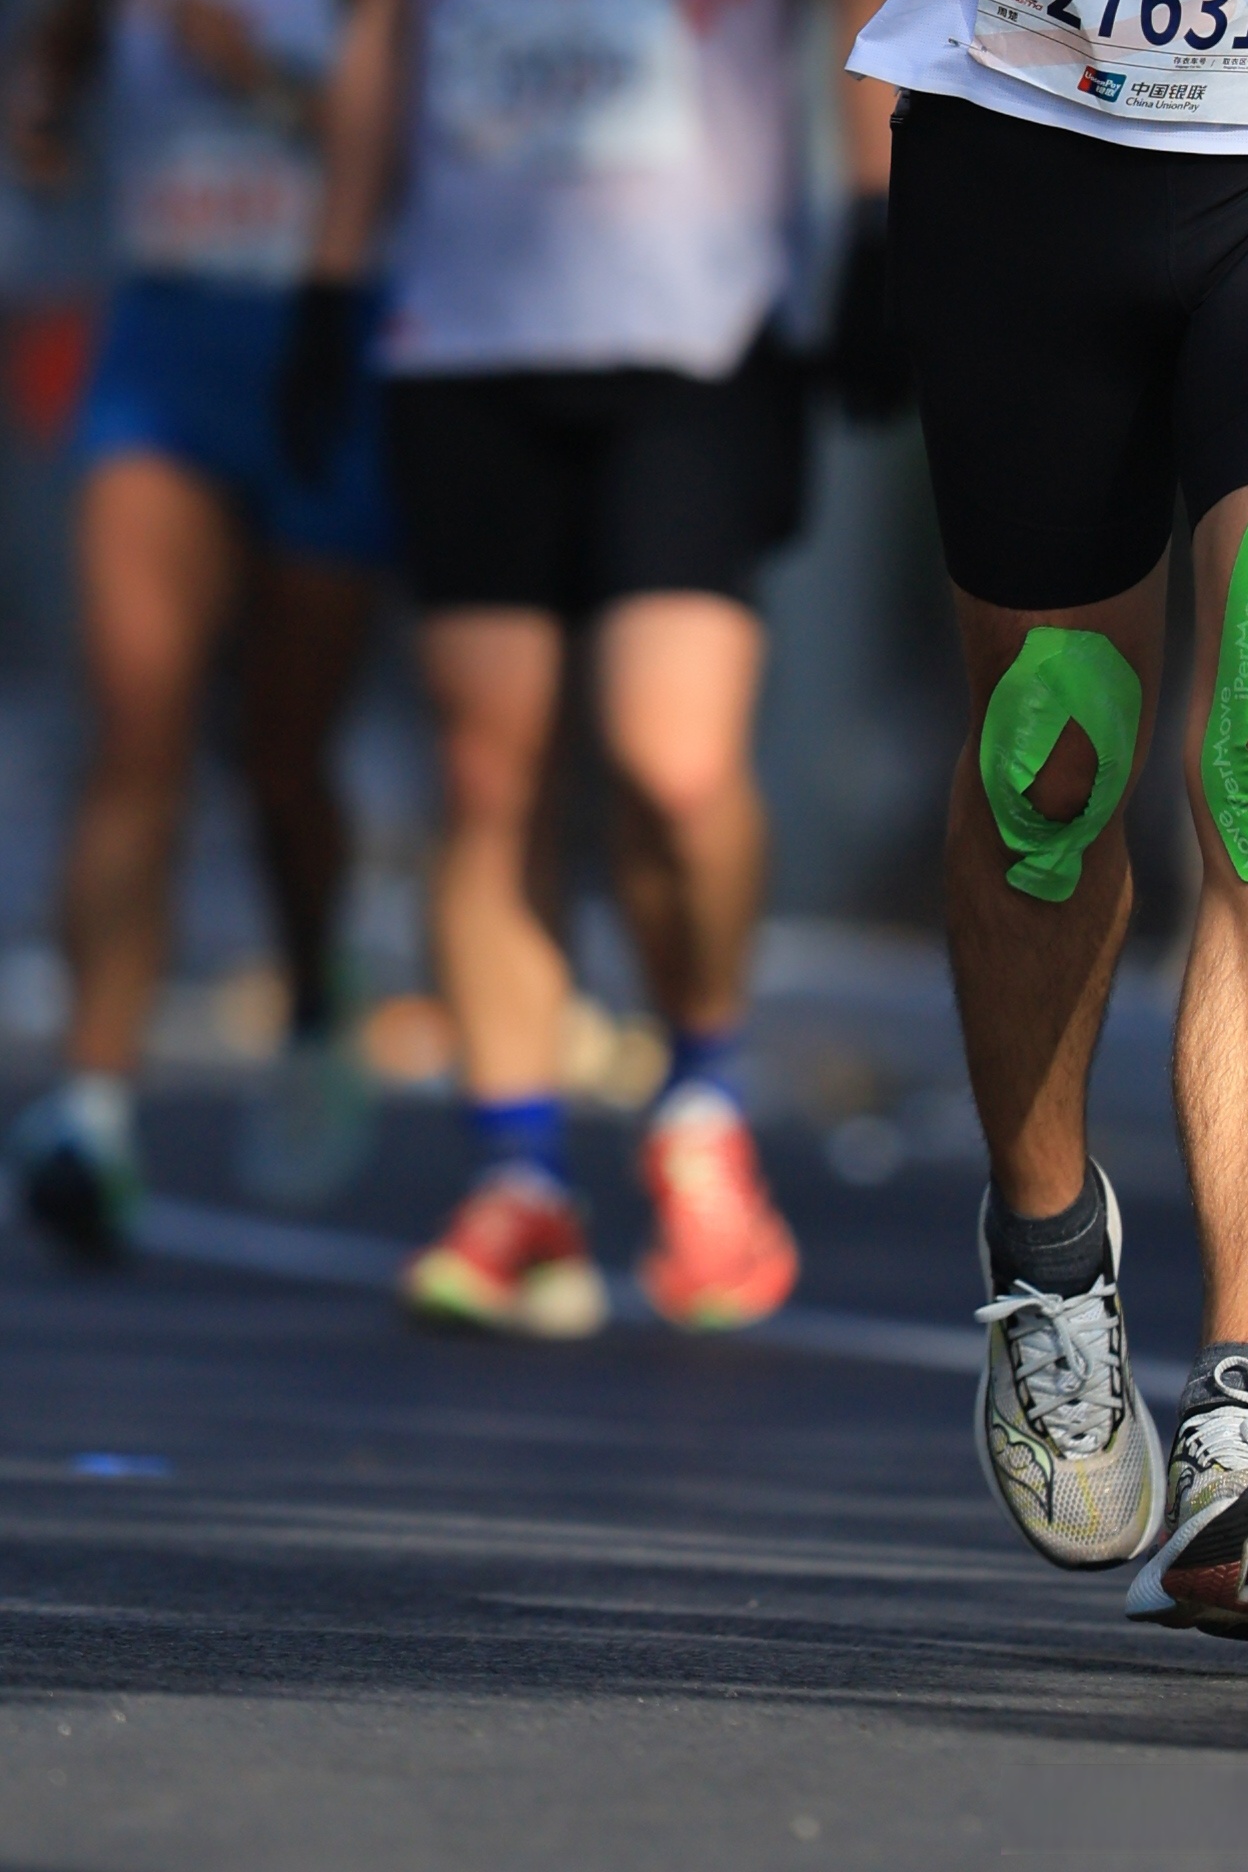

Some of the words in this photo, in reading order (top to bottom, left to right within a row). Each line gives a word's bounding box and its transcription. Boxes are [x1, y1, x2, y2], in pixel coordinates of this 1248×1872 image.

[1131, 81, 1208, 101] 中国银联
[1125, 96, 1154, 109] China
[1155, 100, 1200, 113] UnionPay
